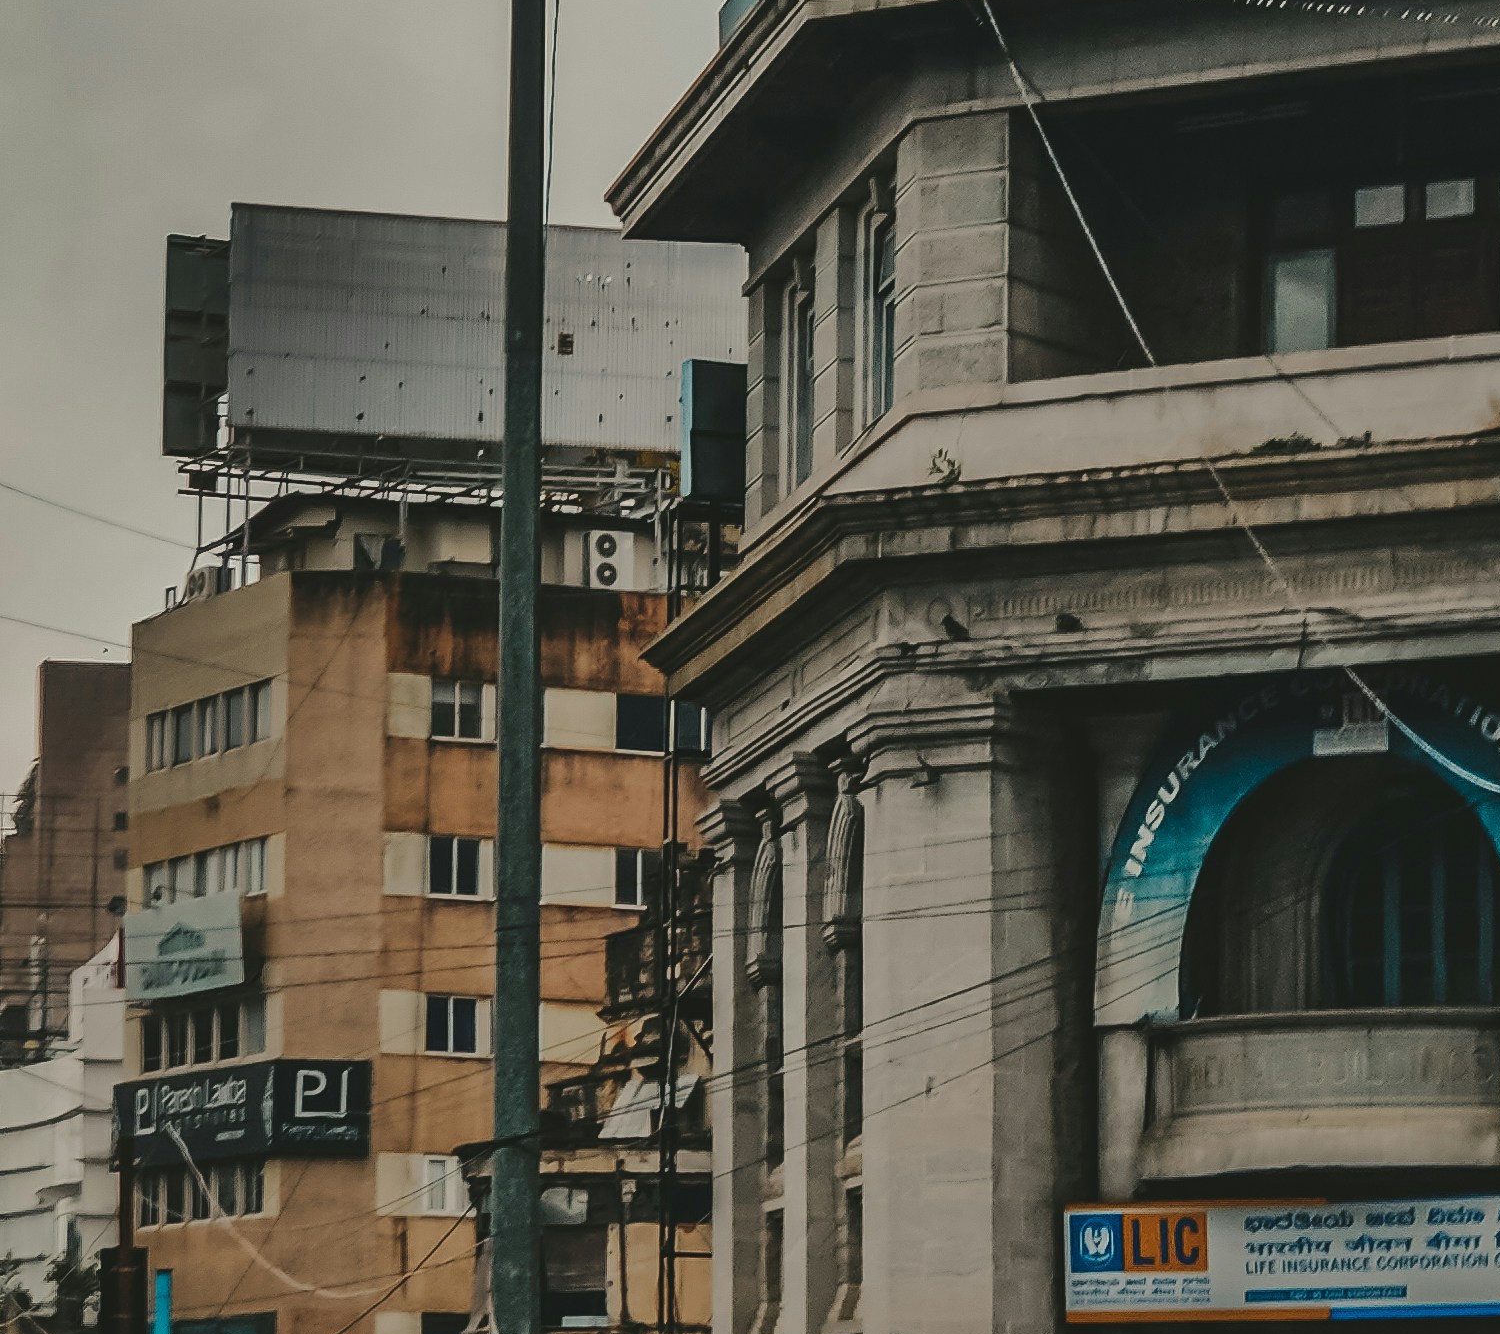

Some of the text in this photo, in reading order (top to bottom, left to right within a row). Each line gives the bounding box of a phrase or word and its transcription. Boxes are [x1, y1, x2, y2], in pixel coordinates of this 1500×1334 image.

[1122, 683, 1279, 878] INSURANCE
[1131, 1216, 1200, 1266] LIC
[1245, 1259, 1277, 1275] LIFE
[1282, 1257, 1371, 1274] INSURANCE
[1376, 1253, 1488, 1271] CORPORATION
